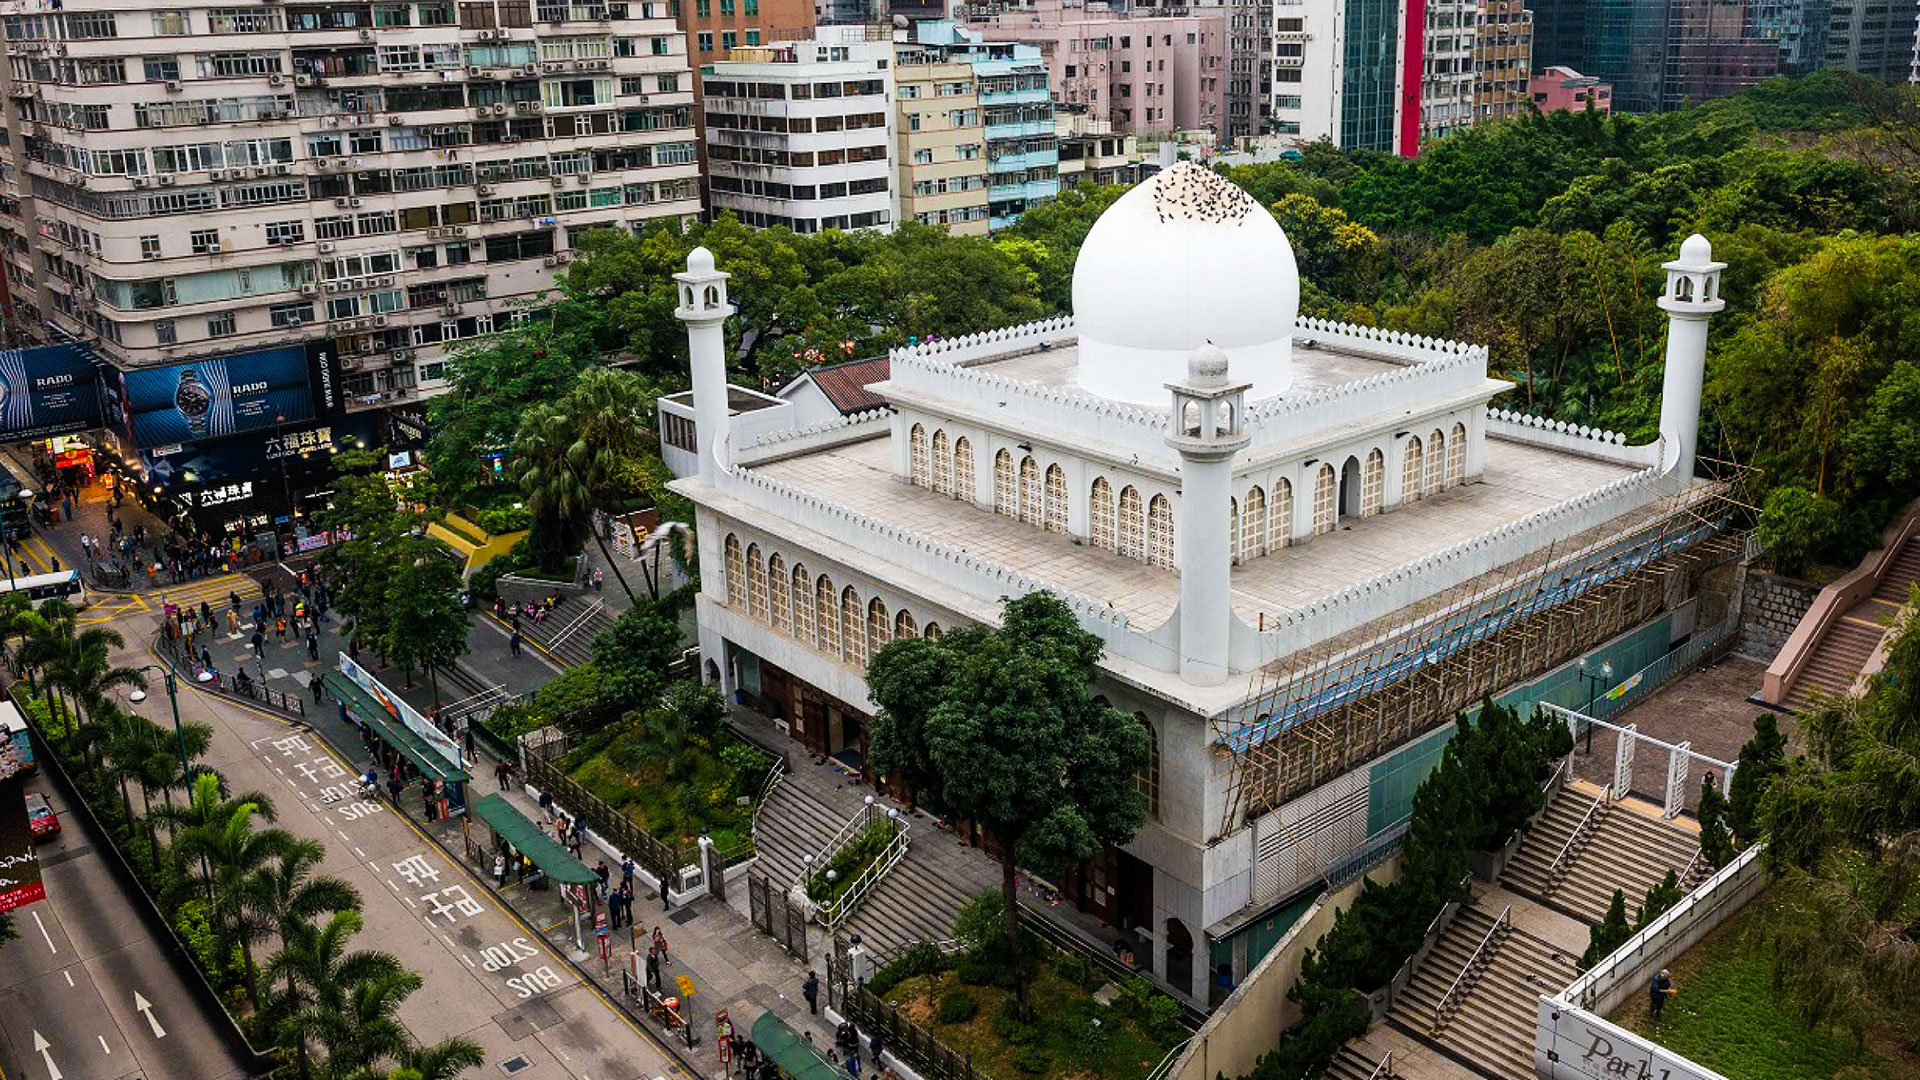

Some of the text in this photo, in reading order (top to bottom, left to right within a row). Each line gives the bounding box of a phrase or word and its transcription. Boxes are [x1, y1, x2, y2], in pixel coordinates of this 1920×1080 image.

[36, 373, 73, 387] RADO
[232, 381, 268, 394] RADO
[271, 734, 313, 759] 站
[293, 756, 347, 783] 巴士
[338, 799, 384, 821] BUS
[391, 854, 442, 888] 站
[420, 884, 485, 923] 巴士
[479, 937, 540, 972] STOP
[506, 965, 563, 999] BUS
